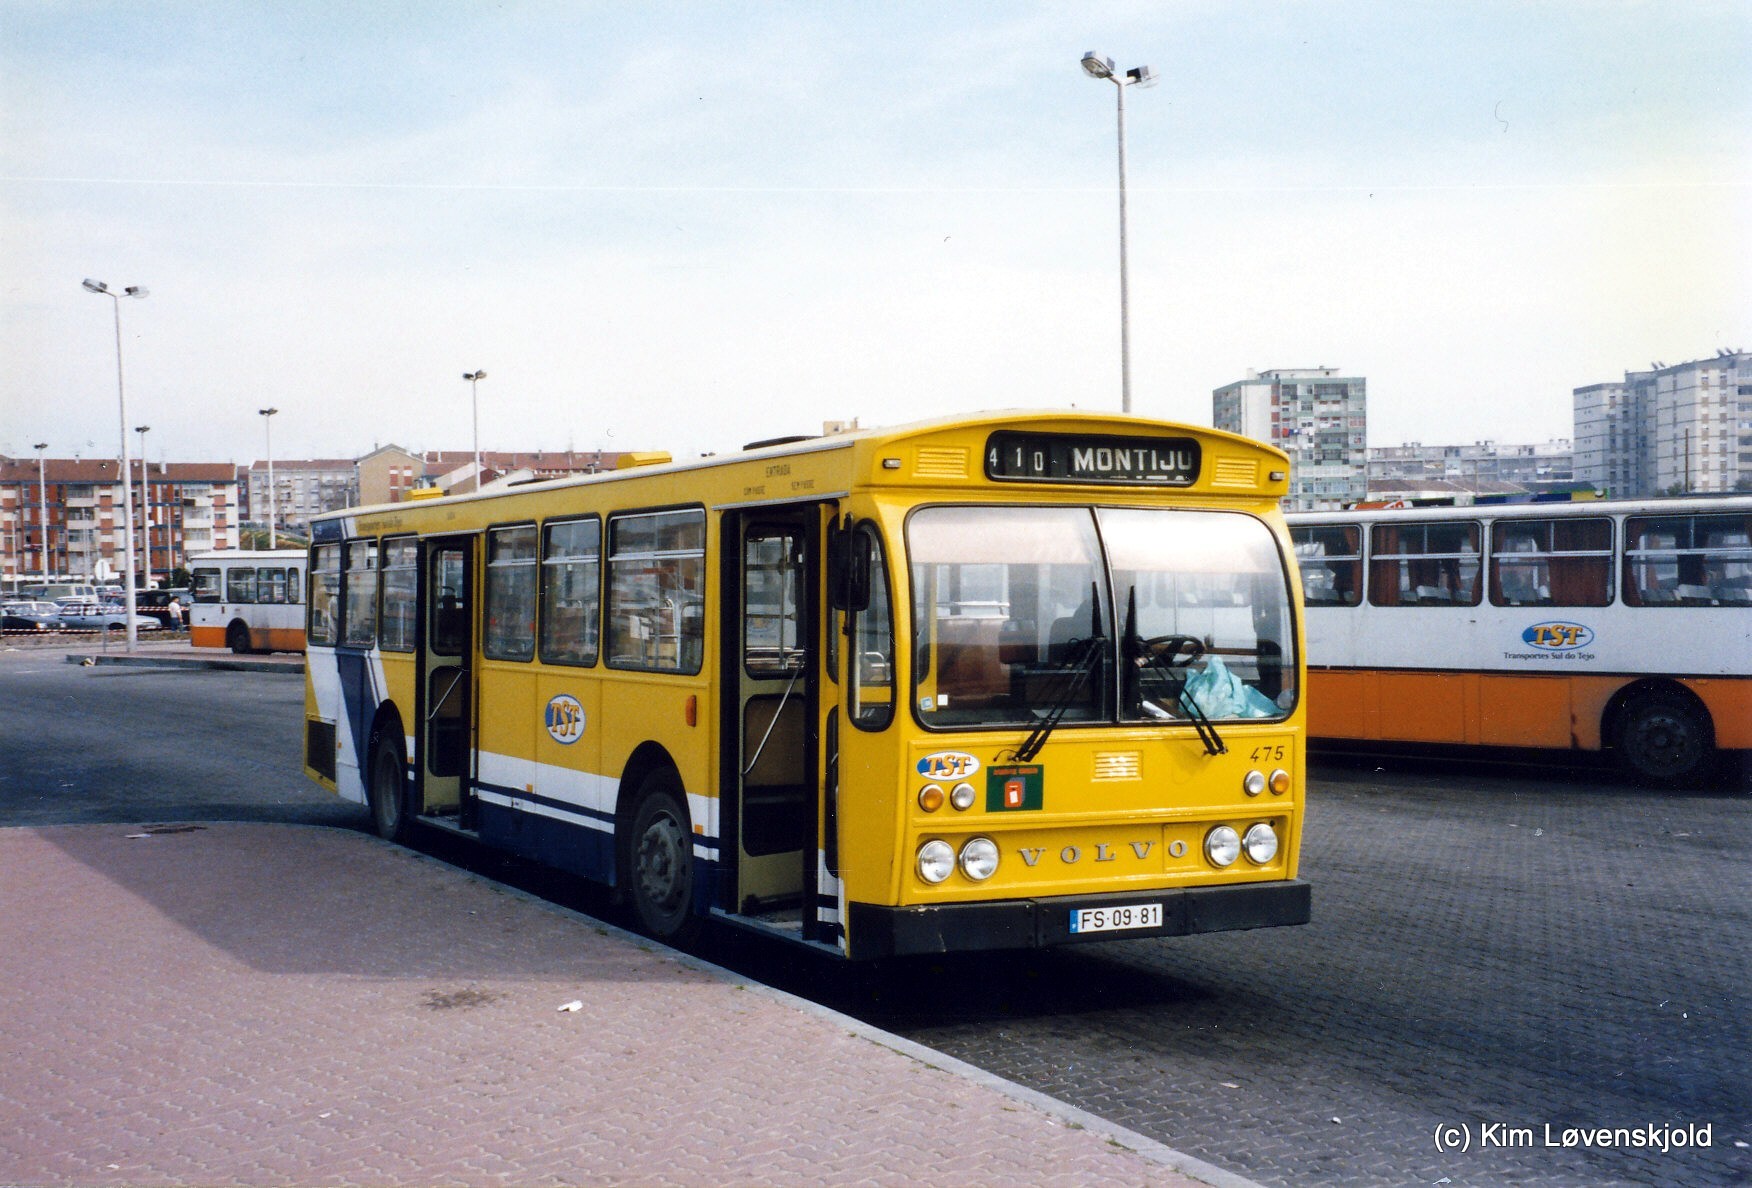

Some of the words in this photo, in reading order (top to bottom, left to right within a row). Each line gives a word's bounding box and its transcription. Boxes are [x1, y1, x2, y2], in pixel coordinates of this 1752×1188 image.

[1533, 624, 1584, 647] TST
[1503, 652, 1549, 661] Transportes
[1551, 652, 1563, 660] Sul
[1565, 652, 1576, 660] do
[1578, 652, 1595, 661] Tejo
[551, 700, 581, 737] TST
[926, 754, 971, 777] TST
[1250, 745, 1285, 763] 475
[1019, 839, 1189, 867] VOLVO
